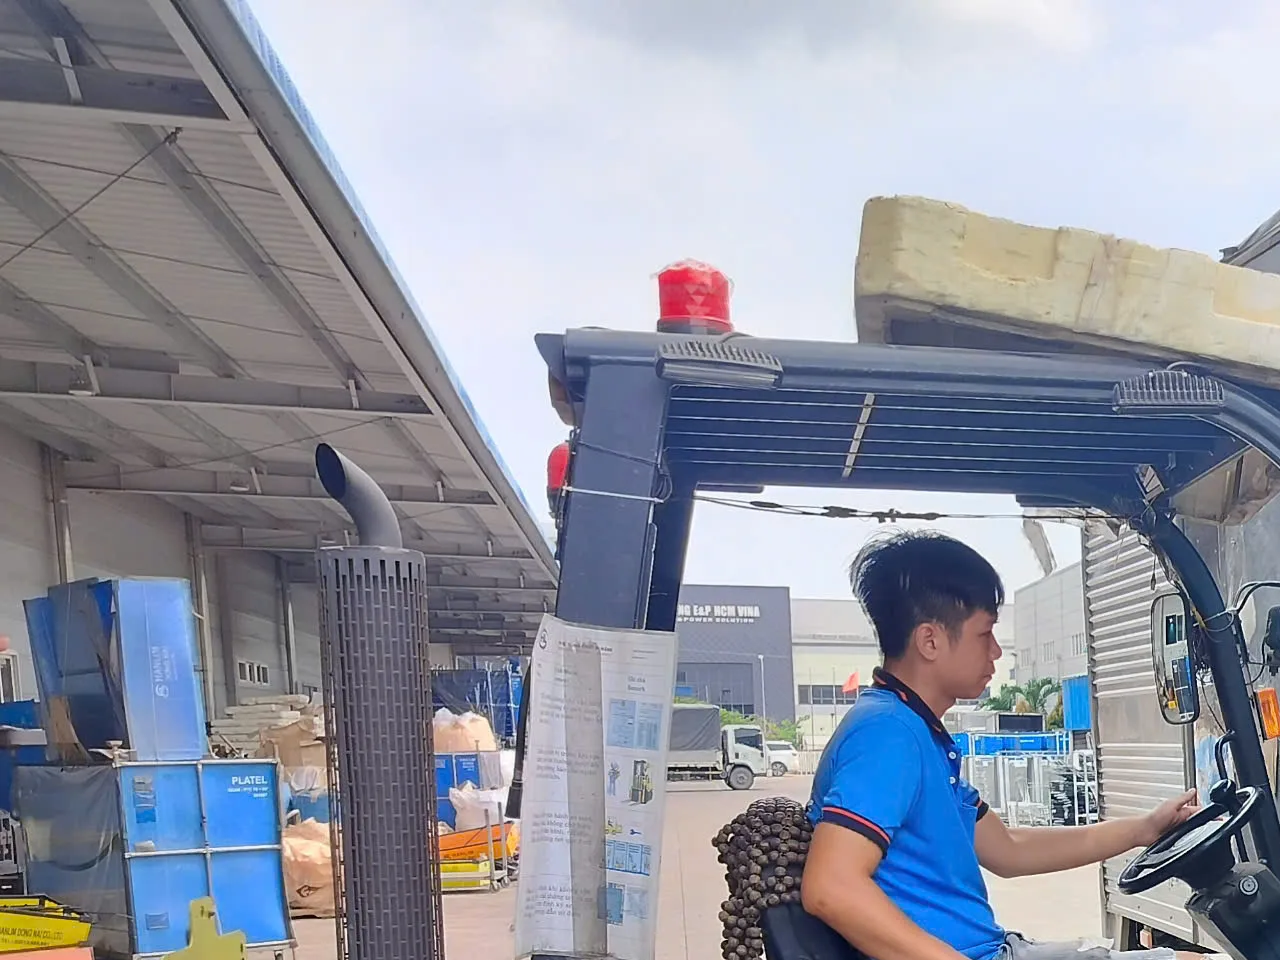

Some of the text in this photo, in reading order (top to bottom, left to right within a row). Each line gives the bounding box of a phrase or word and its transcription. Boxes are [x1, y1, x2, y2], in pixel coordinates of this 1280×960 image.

[693, 605, 711, 617] E&P
[713, 605, 736, 617] HCM
[737, 606, 760, 618] VINA
[231, 775, 268, 785] PLATEL
